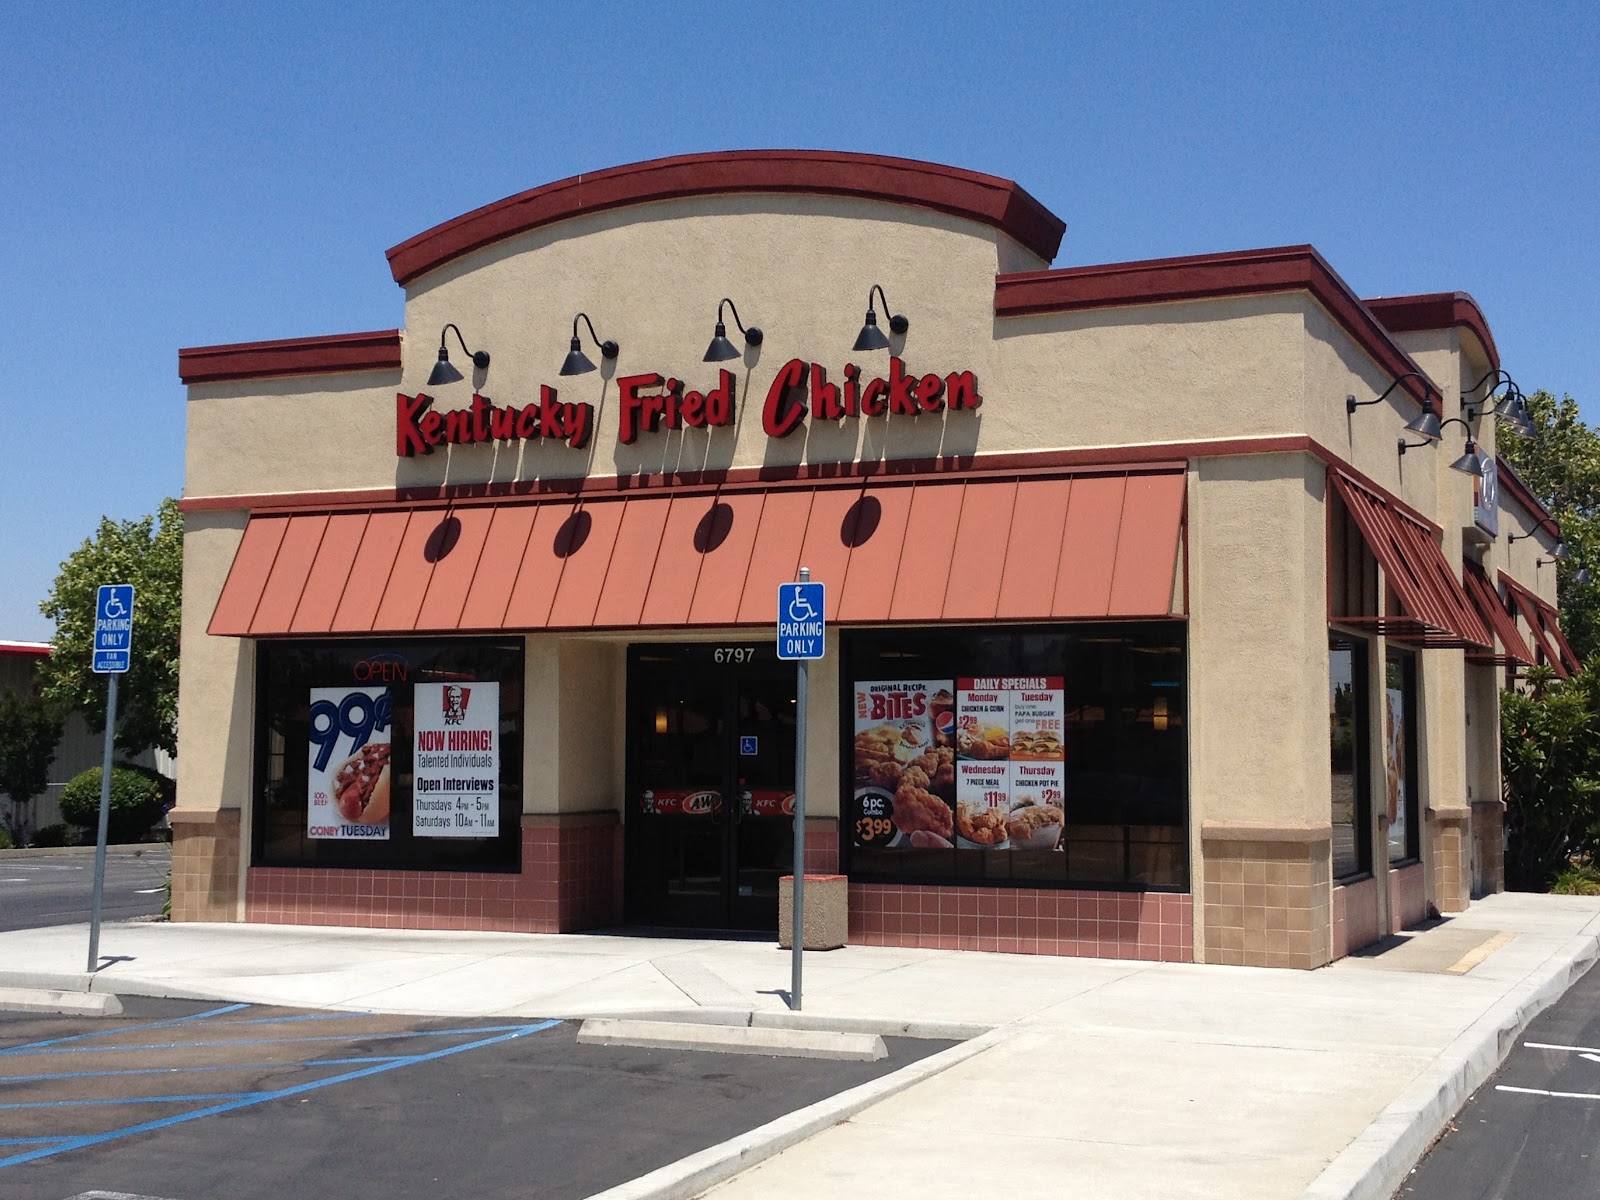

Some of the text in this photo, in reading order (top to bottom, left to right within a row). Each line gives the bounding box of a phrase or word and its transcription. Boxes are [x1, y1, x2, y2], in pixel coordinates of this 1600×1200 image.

[396, 356, 983, 456] Kentucky Fried Chicken
[97, 618, 130, 631] PARKING
[780, 621, 822, 637] PARKING
[101, 633, 124, 646] ONLY
[786, 640, 815, 654] ONLY
[106, 652, 117, 660] VAN
[713, 648, 755, 663] 6797
[97, 661, 125, 669] ACCESSIBLE
[354, 660, 408, 682] OPEN
[870, 683, 927, 693] ORIGINAL RECIPE
[973, 678, 1047, 690] DAILY SPECIALS
[967, 693, 998, 704] Monday
[1021, 692, 1054, 703] Tuesday
[857, 692, 867, 718] NEW
[870, 692, 927, 721] BITES
[961, 705, 984, 713] CHICKEN
[1035, 719, 1060, 730] FREE
[418, 730, 492, 751] NOW HIRING!
[417, 754, 492, 768] Talented Individuals
[961, 765, 1006, 775] Wednesday
[1020, 766, 1055, 776] Thursday
[417, 777, 494, 792] Open Interviews
[416, 798, 452, 811] Thursdays
[658, 798, 677, 806] KFC
[756, 799, 776, 807] KFC
[415, 815, 451, 828] Saturdays
[310, 825, 387, 837] CONEY TUESDAY
